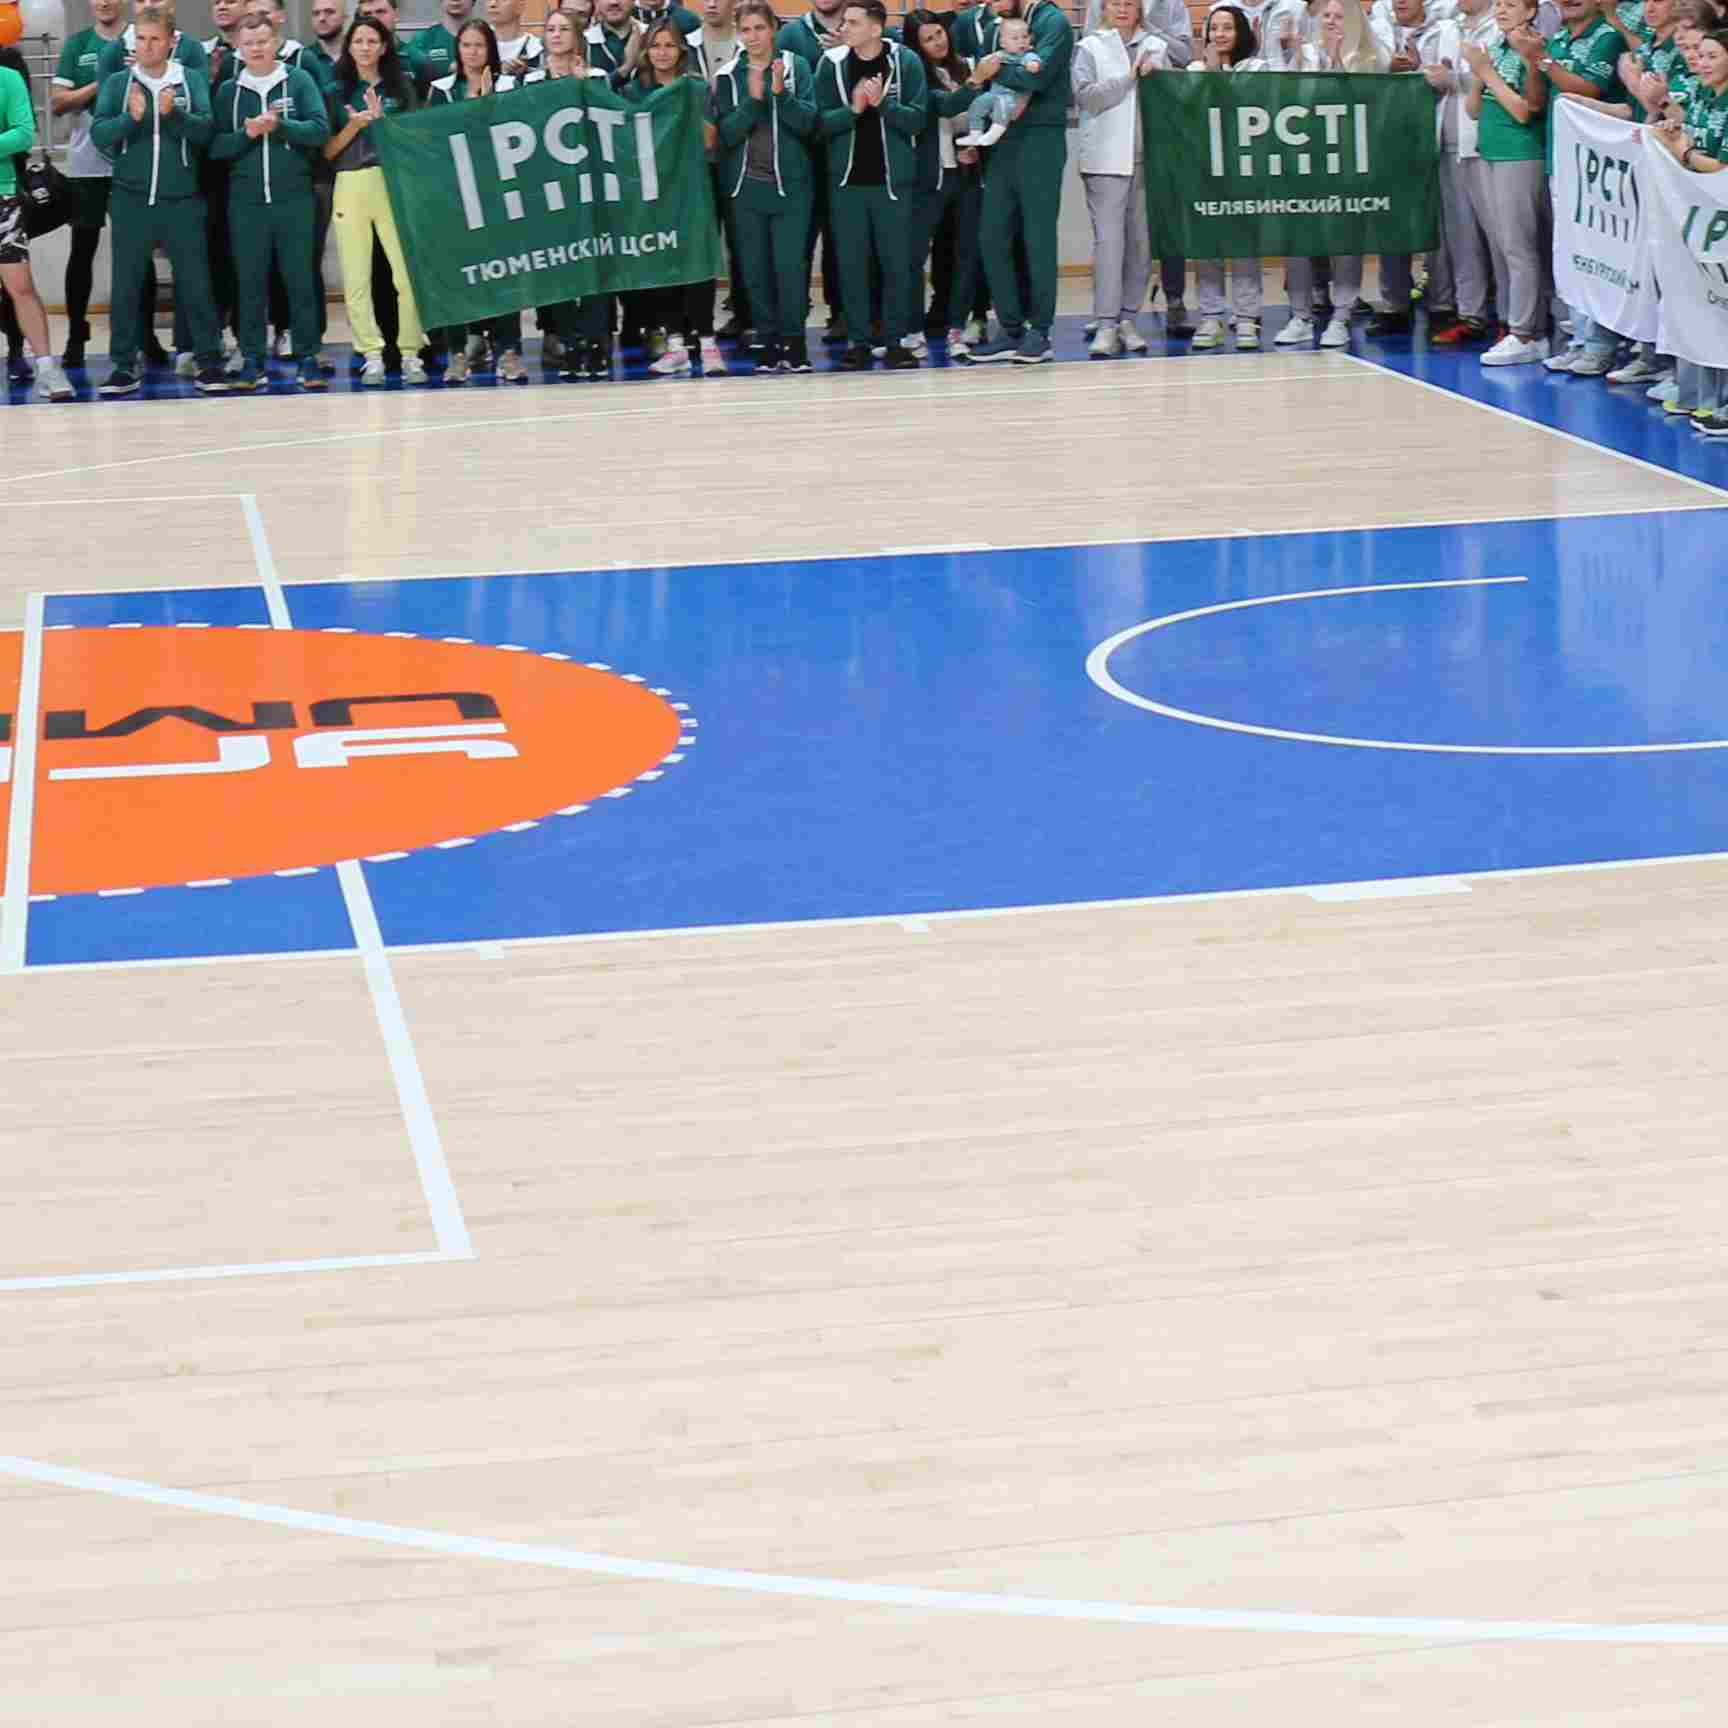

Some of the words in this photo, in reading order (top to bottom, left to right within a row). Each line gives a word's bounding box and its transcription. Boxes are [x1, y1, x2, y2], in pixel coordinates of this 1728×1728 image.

[488, 105, 625, 181] РСТ
[1237, 104, 1348, 147] РСТ
[1193, 196, 1343, 216] ЧЕЛЯБИНСКИЙ
[1345, 196, 1391, 214] ЦСМ
[620, 229, 679, 258] ЦСМ
